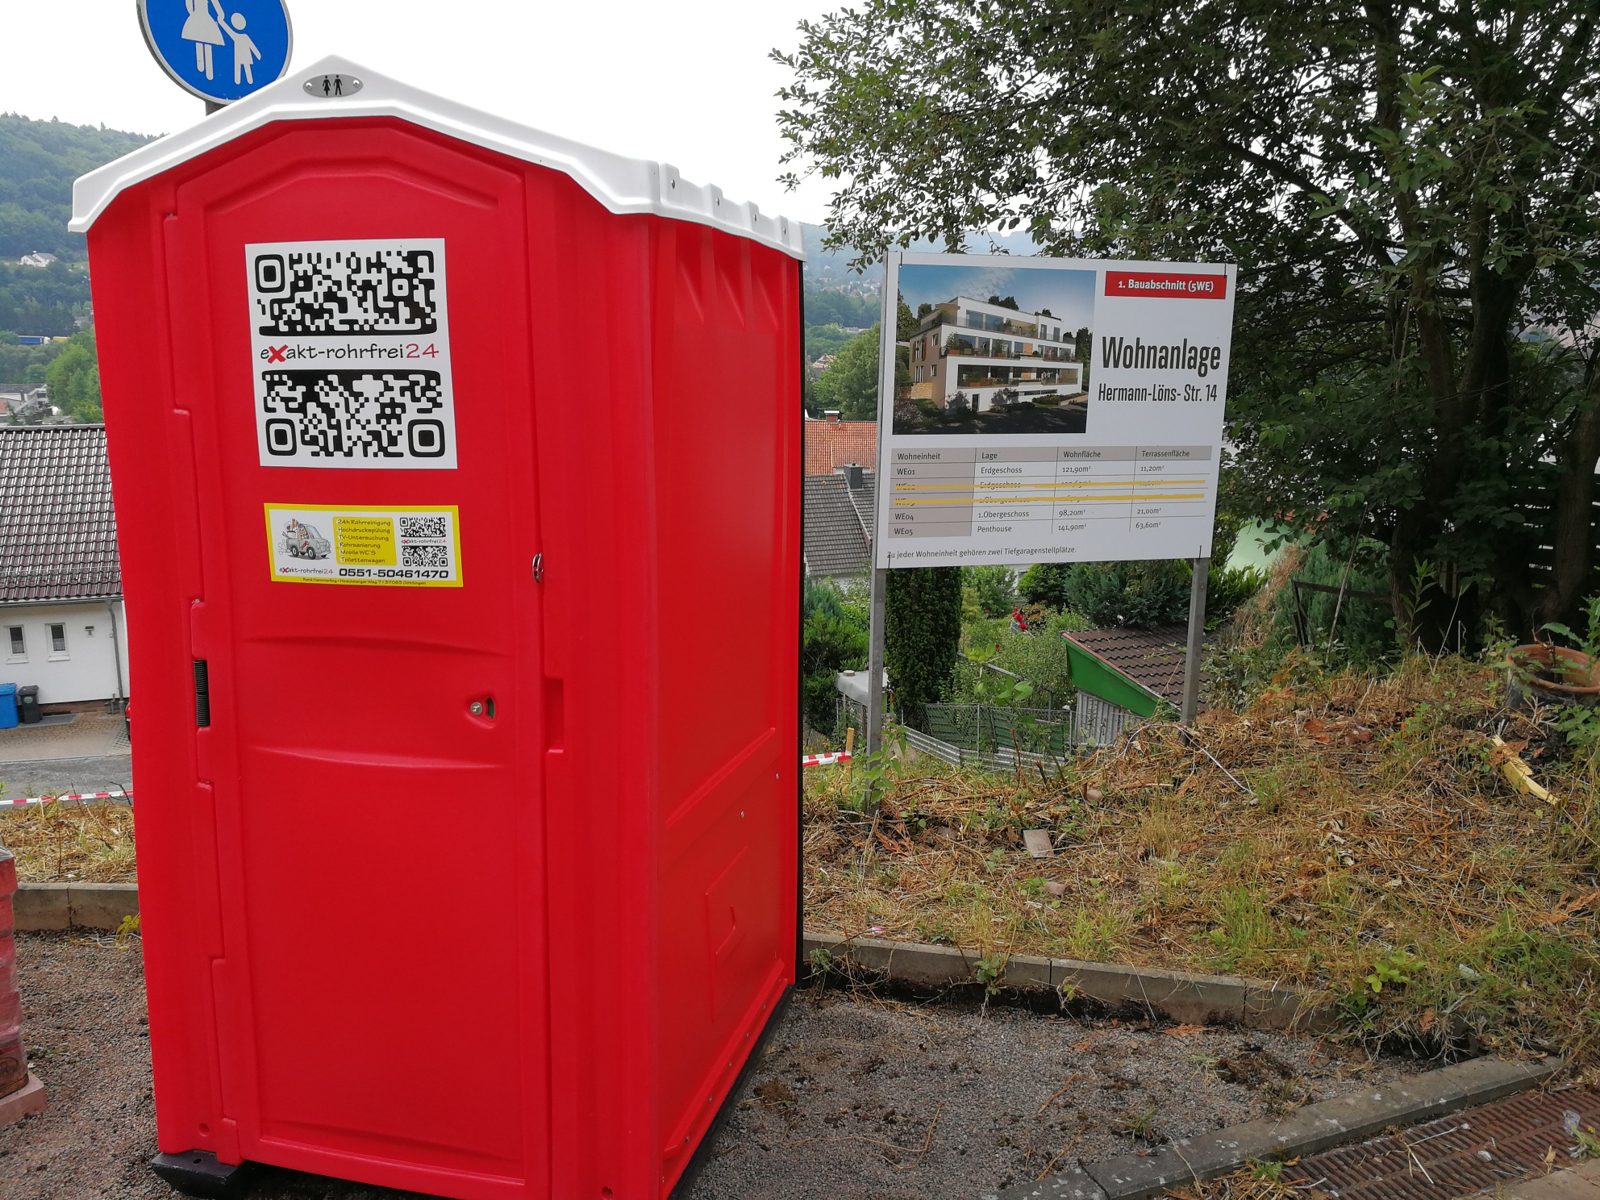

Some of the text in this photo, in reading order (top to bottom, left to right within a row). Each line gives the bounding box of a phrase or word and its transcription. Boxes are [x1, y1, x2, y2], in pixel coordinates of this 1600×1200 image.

[1118, 279, 1214, 293] 1. Bauabschnitt (5WE)
[1102, 336, 1221, 378] Wohnanlage
[1098, 383, 1218, 402] Hermann-Löns- Str. 14
[897, 450, 1190, 461] Wohneinheit Lage Wohnfläche Terrassenfläche
[896, 468, 916, 476] WE01
[980, 466, 1023, 475] Erdgeschoss
[894, 513, 914, 521] WE04
[978, 510, 1030, 520] 1.Obergeschoss
[894, 527, 913, 536] WE05
[977, 525, 1012, 533] Penthouse
[896, 550, 914, 560] jeder
[915, 549, 958, 558] Wohneinheit
[959, 548, 987, 558] gehören
[987, 548, 1003, 556] zwei
[1004, 546, 1077, 556] Tiefgaragenstellplätze.
[339, 568, 449, 579] 0551-50461470
